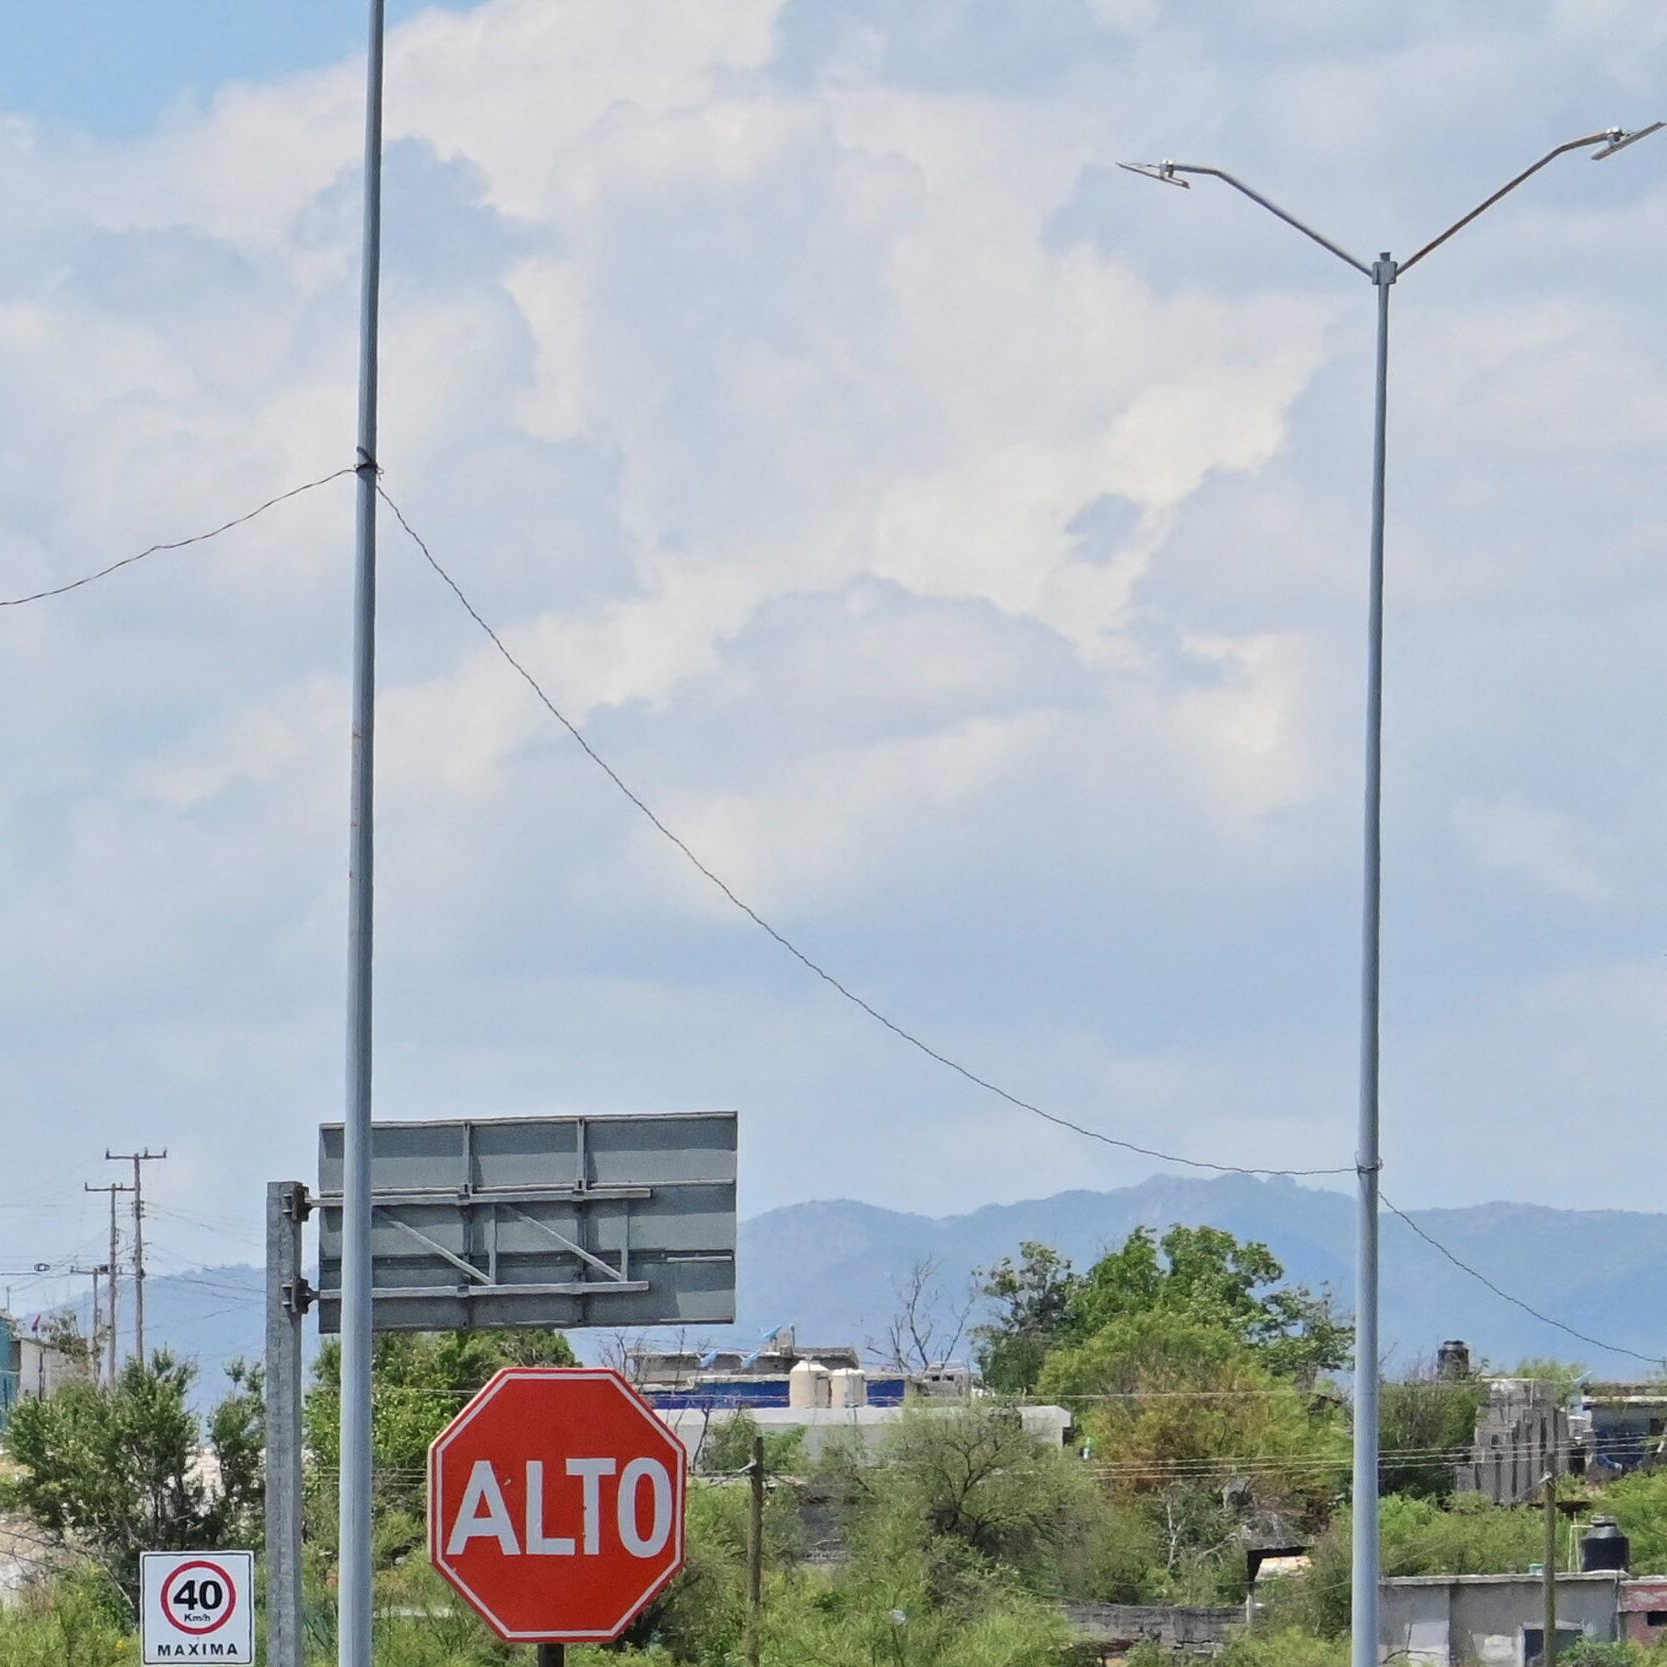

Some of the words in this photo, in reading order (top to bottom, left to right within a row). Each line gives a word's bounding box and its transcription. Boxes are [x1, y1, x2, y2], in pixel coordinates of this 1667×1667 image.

[446, 1457, 673, 1558] ALTO
[173, 1580, 223, 1610] 40
[184, 1614, 211, 1622] Km/h
[157, 1643, 238, 1656] MAXIMA
